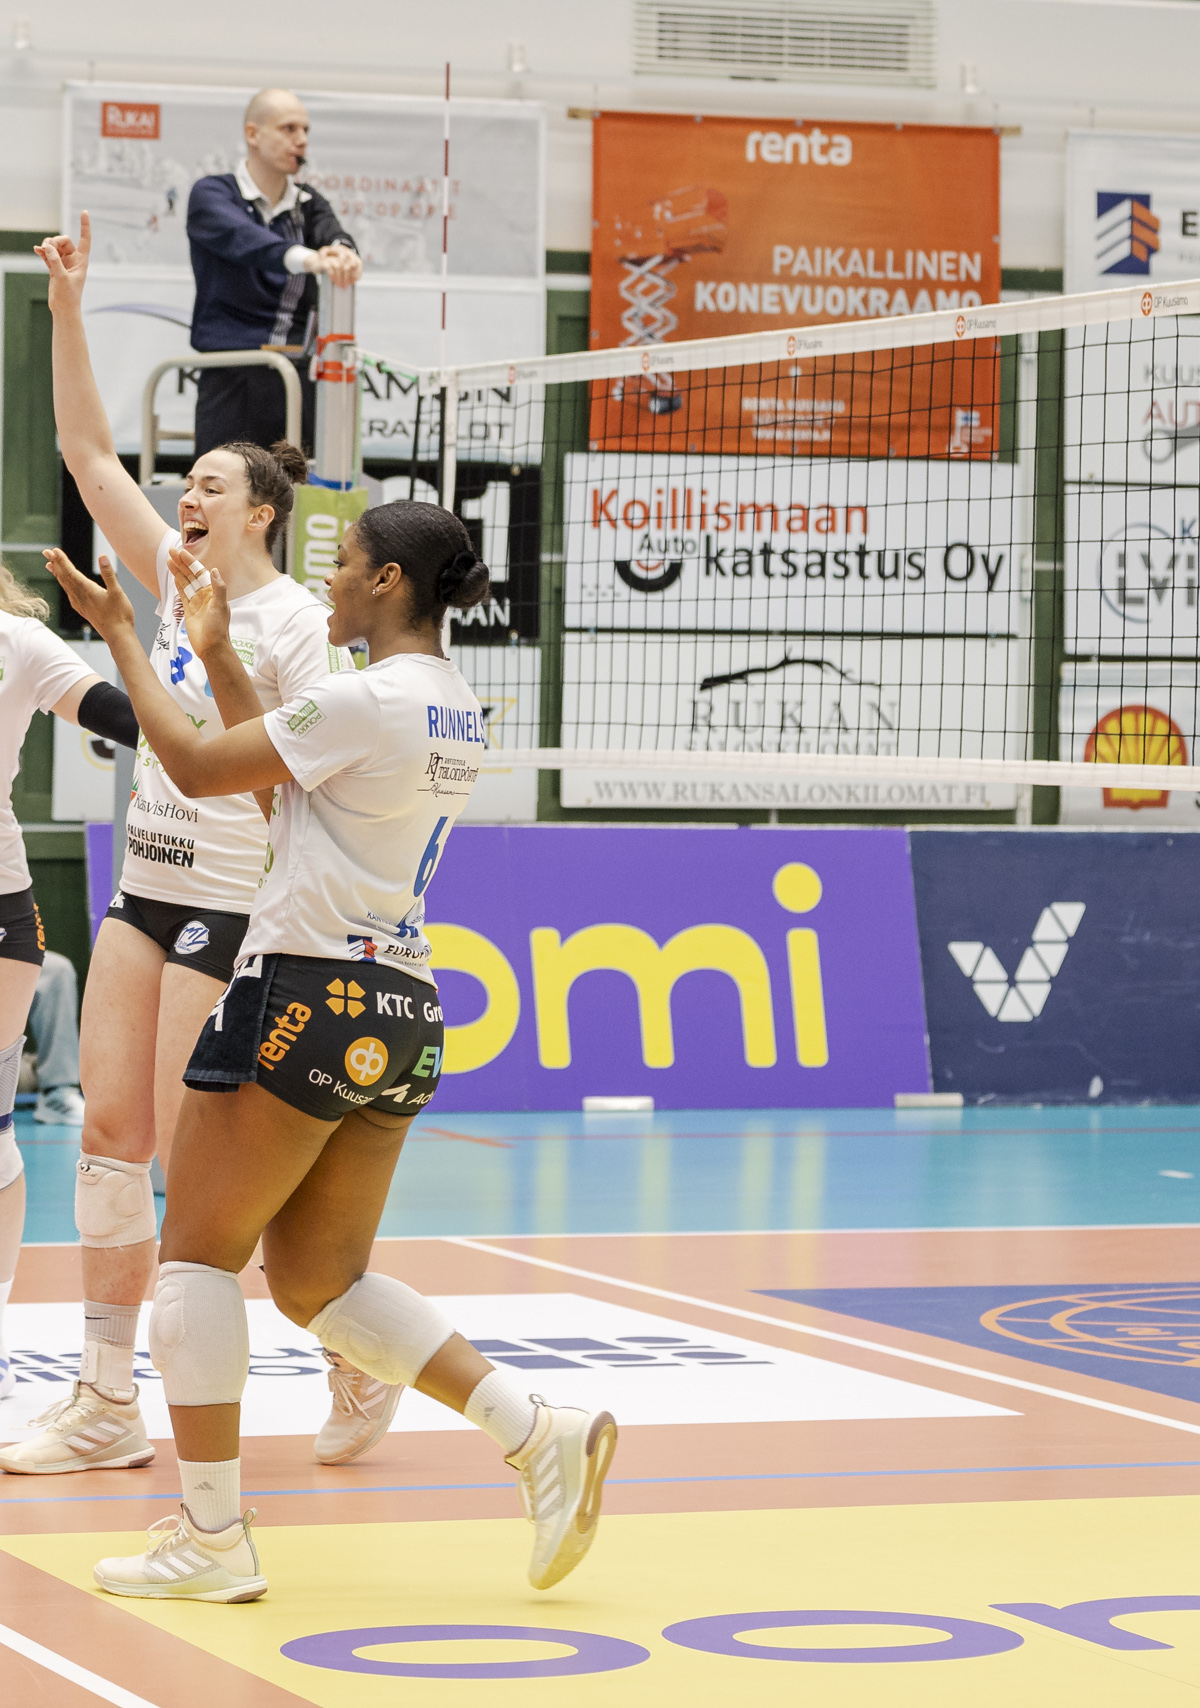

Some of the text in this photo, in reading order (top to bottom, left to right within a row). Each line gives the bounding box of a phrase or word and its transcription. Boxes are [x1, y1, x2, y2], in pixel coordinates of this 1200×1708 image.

[745, 128, 852, 166] renta
[772, 245, 982, 283] PAIKALLINEN
[694, 281, 982, 318] KONEVUOKRAAMO
[590, 488, 869, 536] Koillismaan
[639, 533, 697, 555] Auto
[705, 534, 1004, 592] katsastus Oy
[134, 792, 199, 823] KasvisHovi
[127, 823, 195, 850] PALVELUTUKKU
[127, 836, 195, 869] POHJOINEN
[413, 816, 449, 898] 6
[375, 991, 415, 1020] KTC
[258, 1001, 312, 1071] renta
[308, 1068, 333, 1087] OP
